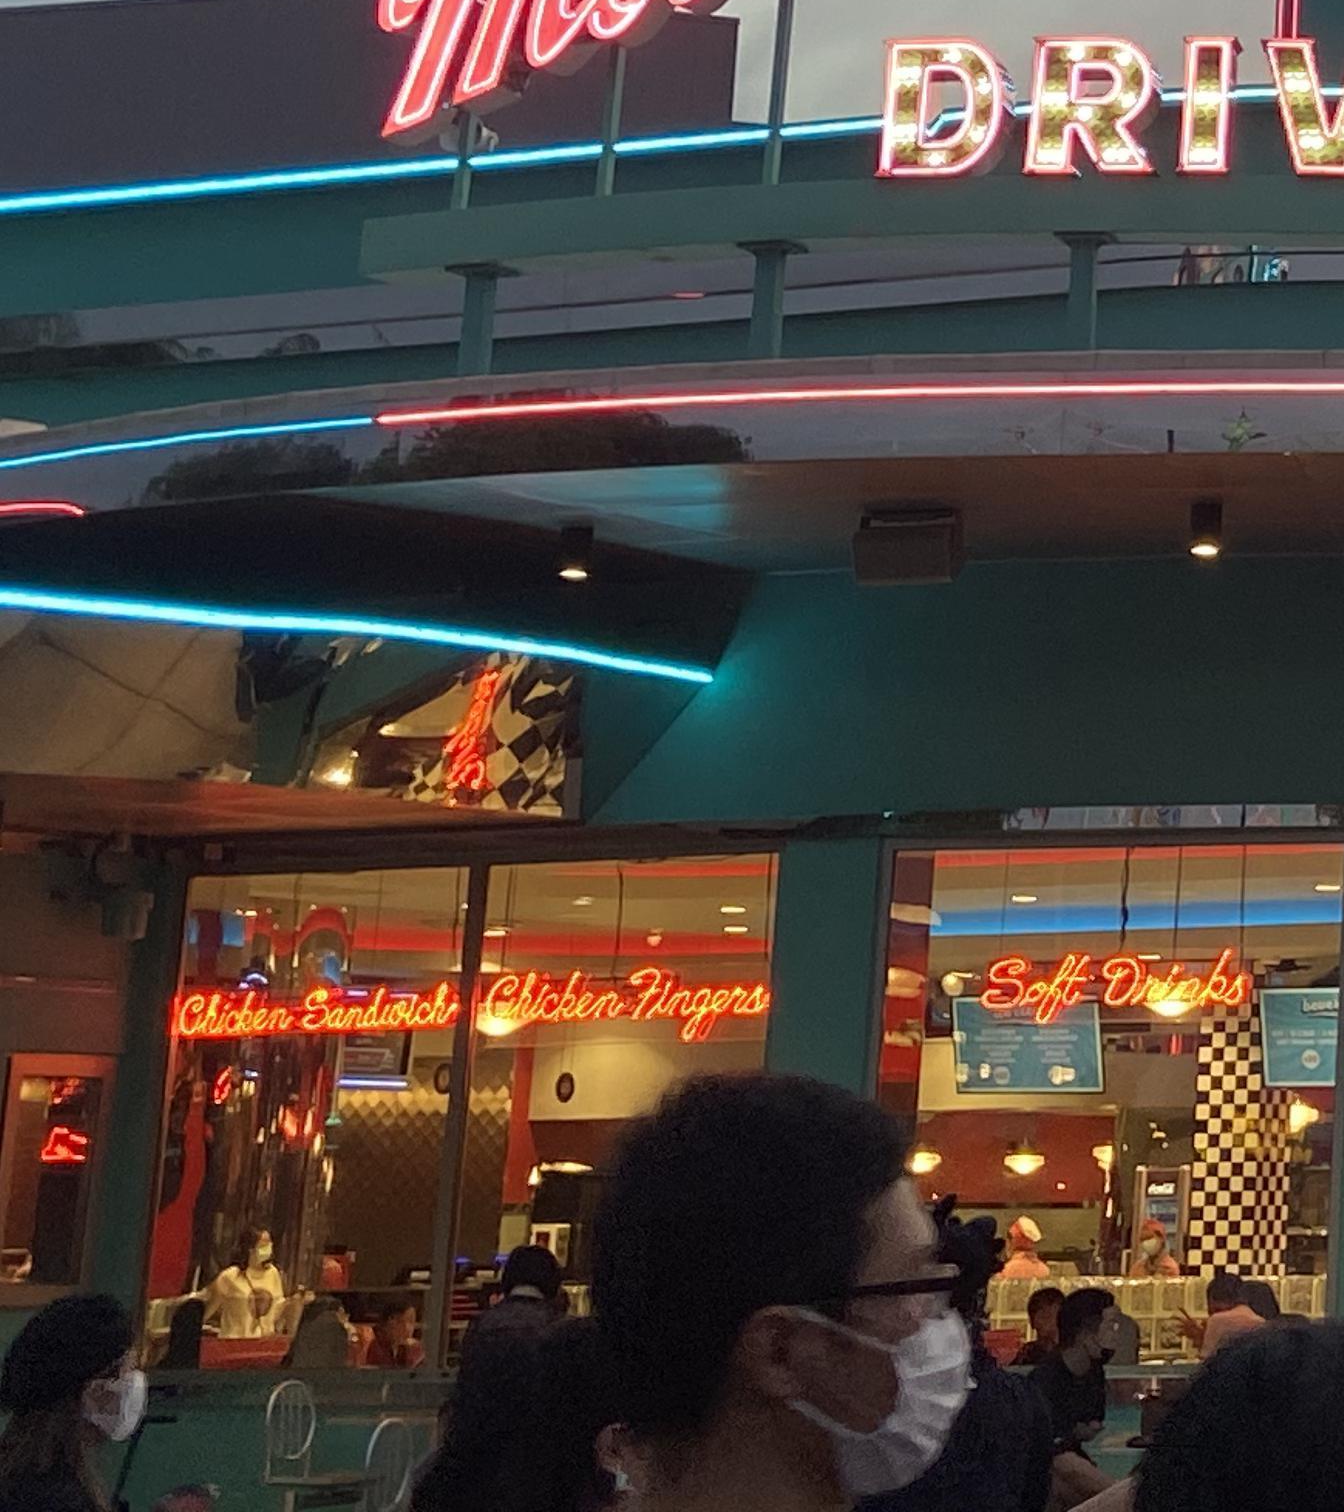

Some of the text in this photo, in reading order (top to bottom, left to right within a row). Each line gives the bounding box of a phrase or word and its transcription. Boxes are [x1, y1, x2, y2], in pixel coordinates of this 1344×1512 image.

[178, 989, 294, 1036] Chicken
[485, 966, 769, 1044] Chicken Fingers
[978, 946, 1250, 1025] Soft Drinks
